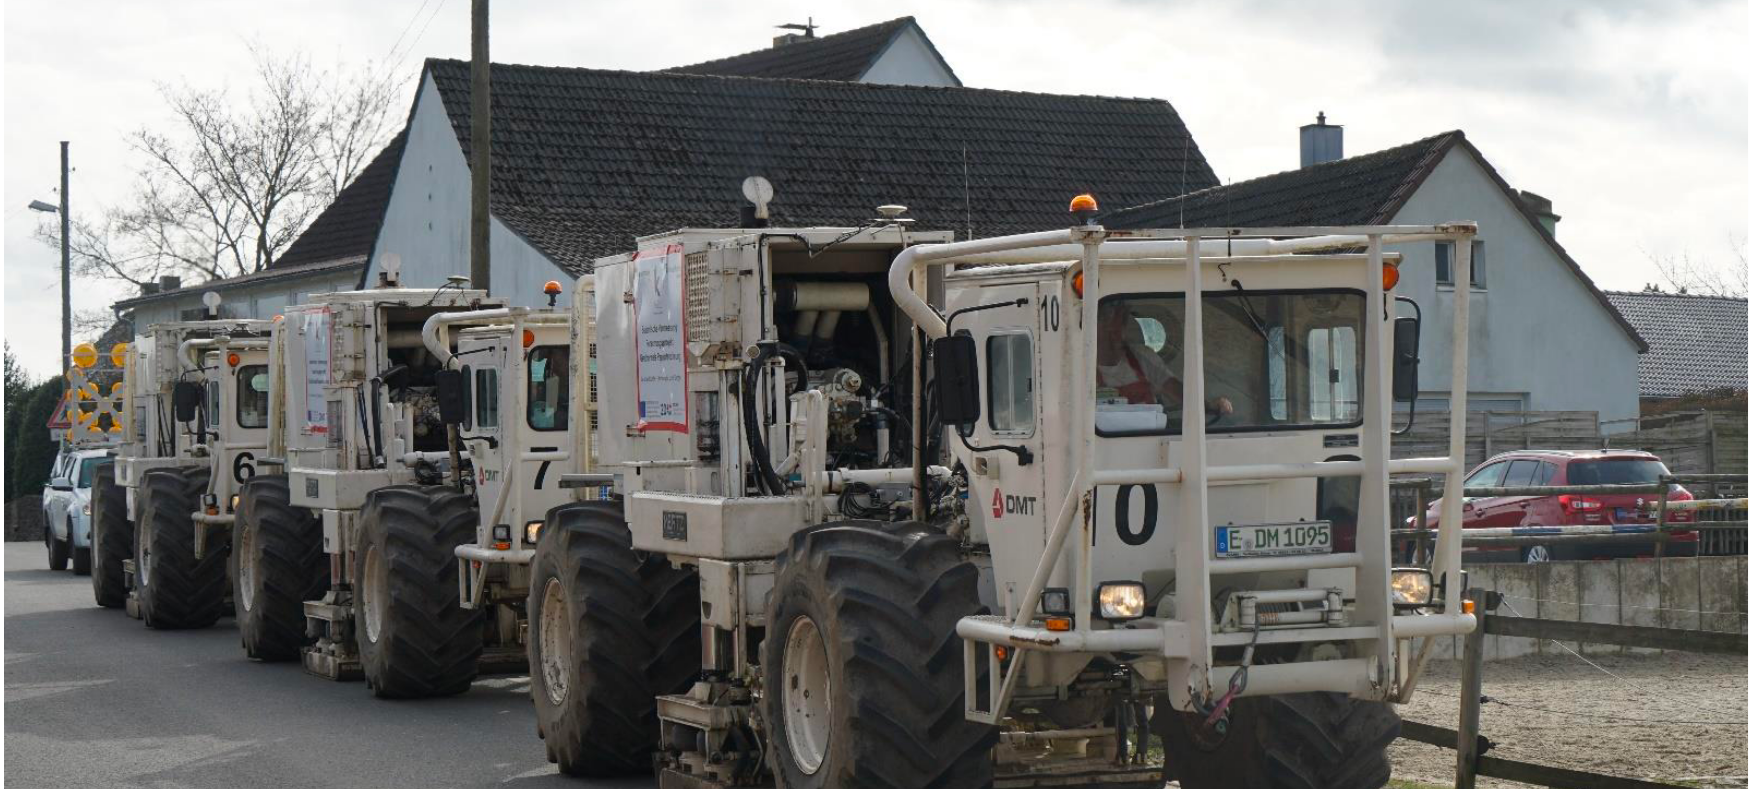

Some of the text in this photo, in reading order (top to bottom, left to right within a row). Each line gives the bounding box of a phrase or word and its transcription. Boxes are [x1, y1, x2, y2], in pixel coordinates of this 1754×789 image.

[1041, 294, 1060, 332] 10
[233, 451, 256, 485] 6
[485, 469, 500, 482] DMT
[530, 446, 559, 490] 7
[1006, 495, 1037, 516] DMT
[1092, 483, 1159, 547] 0
[1229, 525, 1329, 550] E DM 1095
